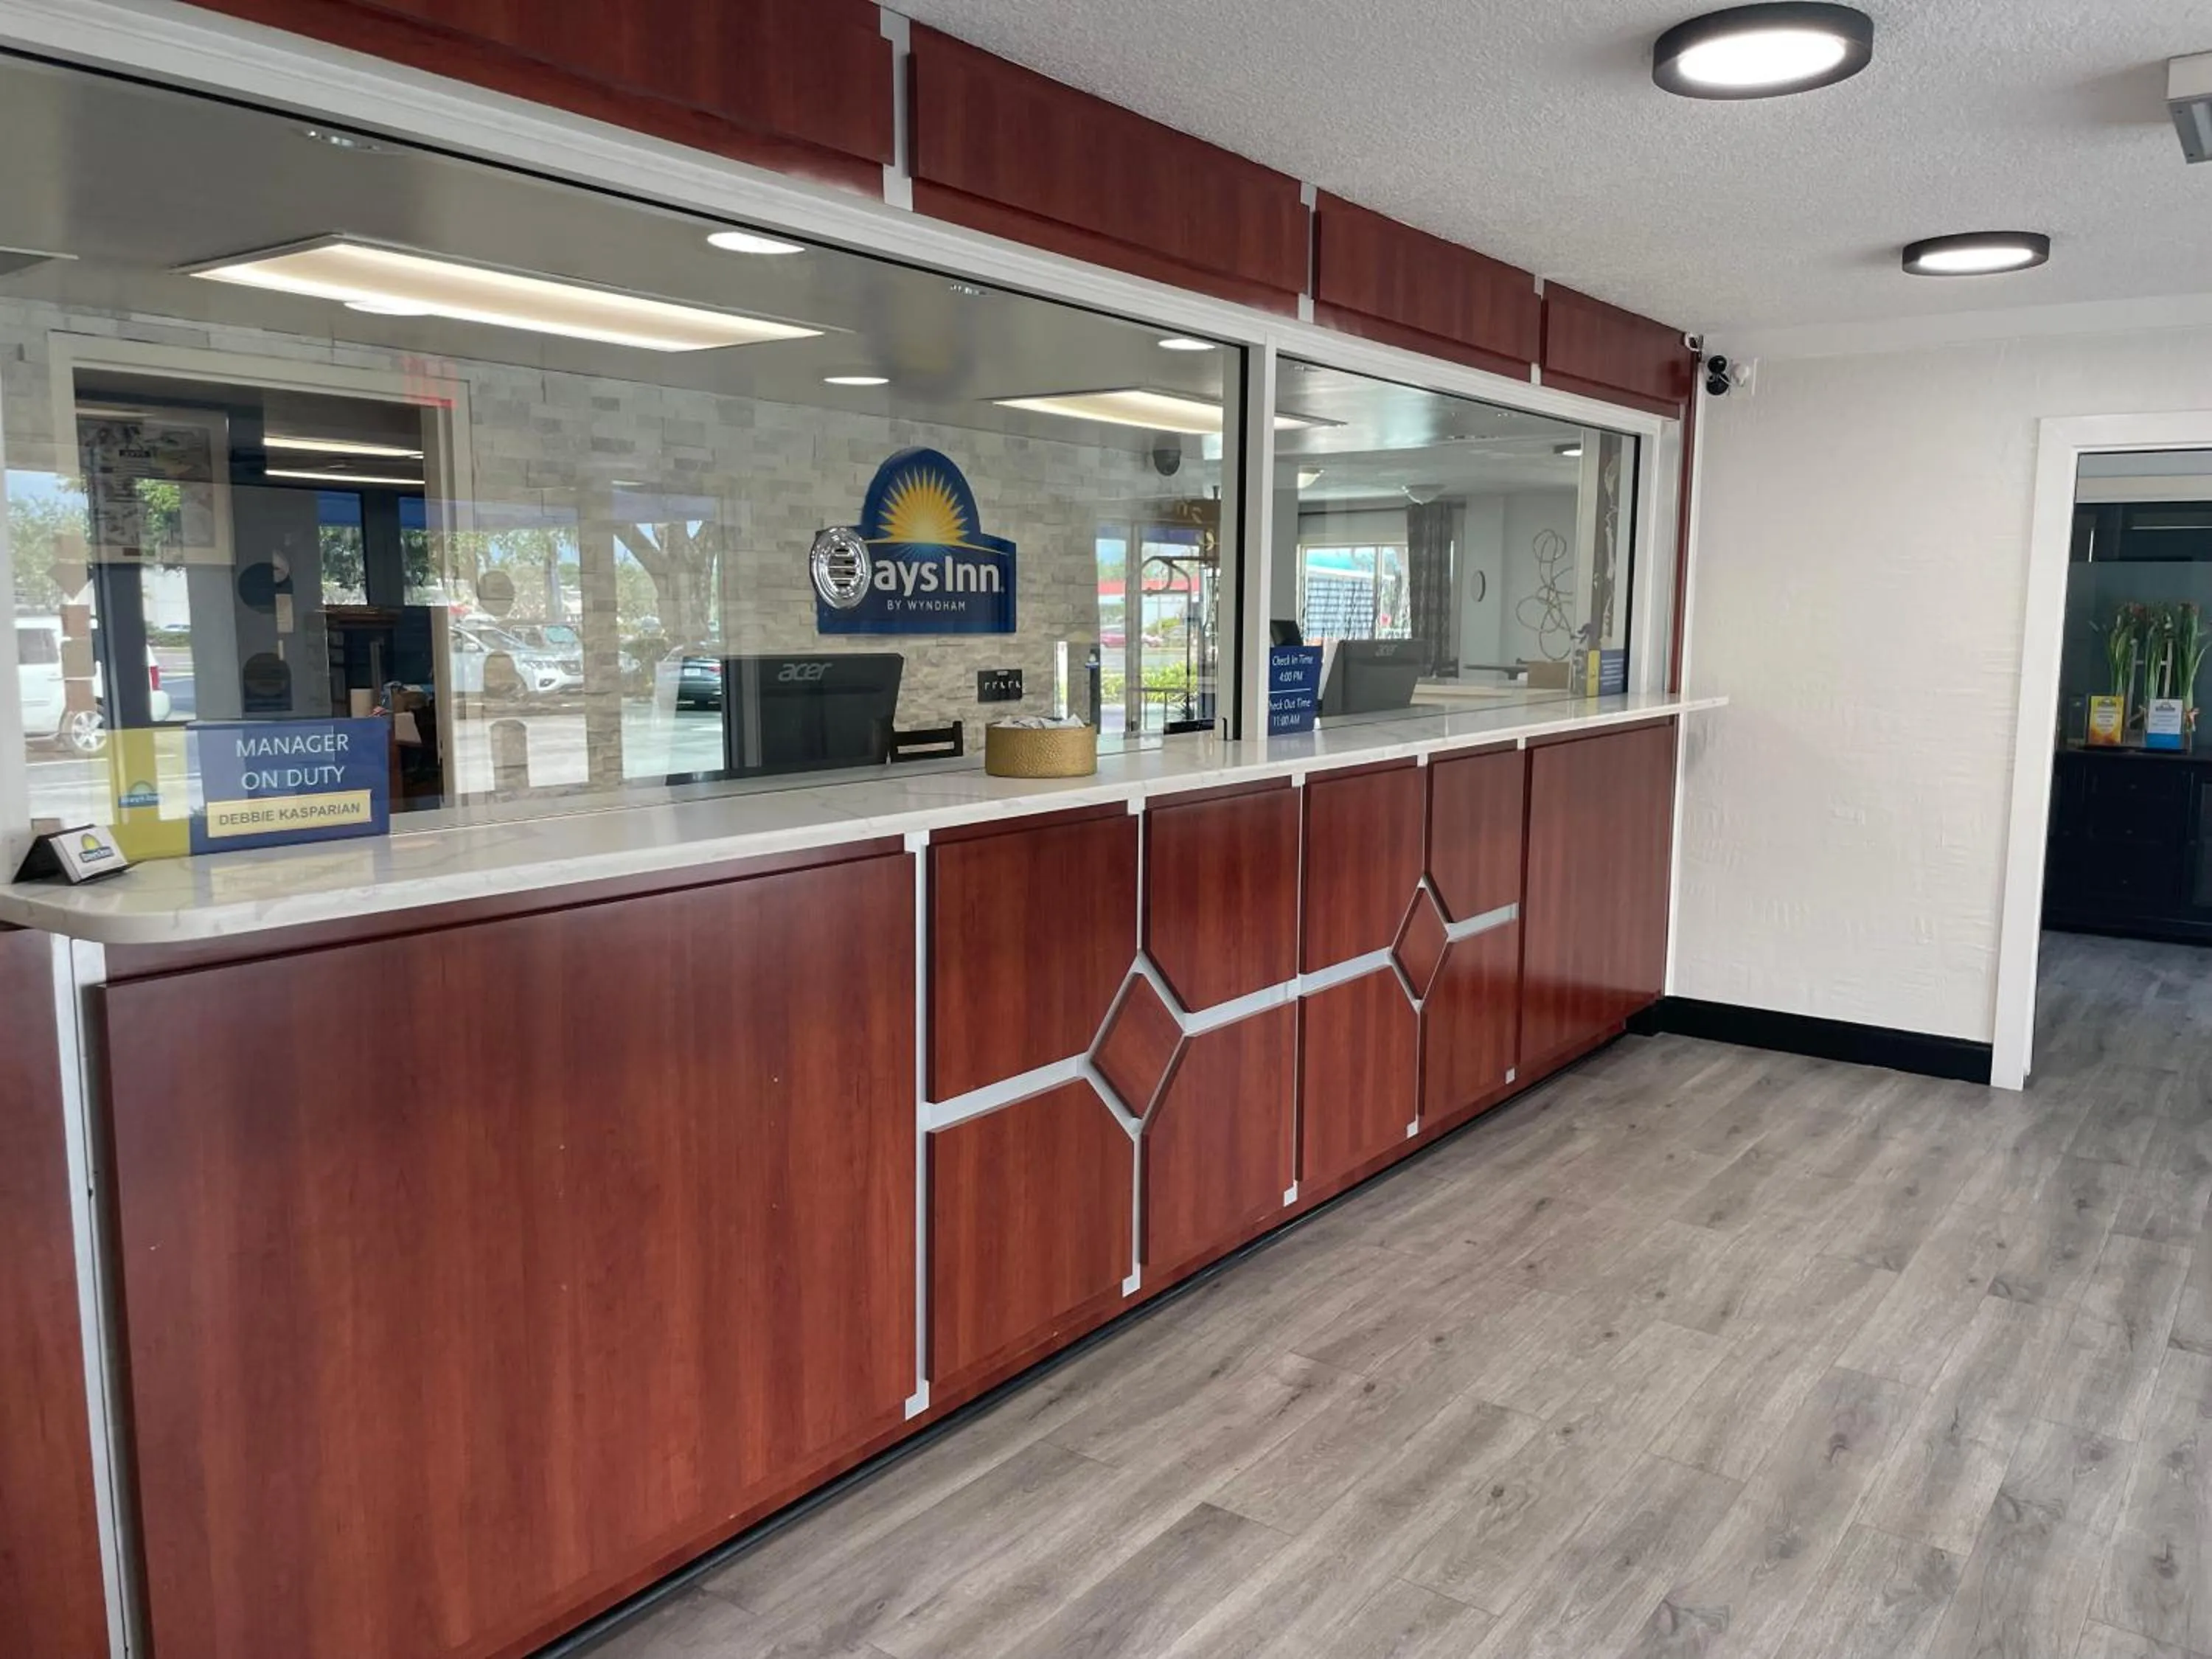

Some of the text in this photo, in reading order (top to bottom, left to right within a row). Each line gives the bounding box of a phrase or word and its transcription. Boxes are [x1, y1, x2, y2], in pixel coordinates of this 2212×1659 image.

[873, 555, 1000, 597] ays Inn
[887, 599, 966, 612] BY WYNDHAM
[1272, 655, 1290, 666] Check
[1298, 654, 1313, 664] Time
[778, 662, 833, 682] acer
[1293, 671, 1303, 681] PM
[1269, 698, 1311, 710] heck Out Time
[1290, 714, 1300, 725] AM
[236, 734, 349, 757] MANAGER
[241, 765, 345, 790] ON DUTY
[219, 801, 361, 826] DEBBIE KASPARIAN
